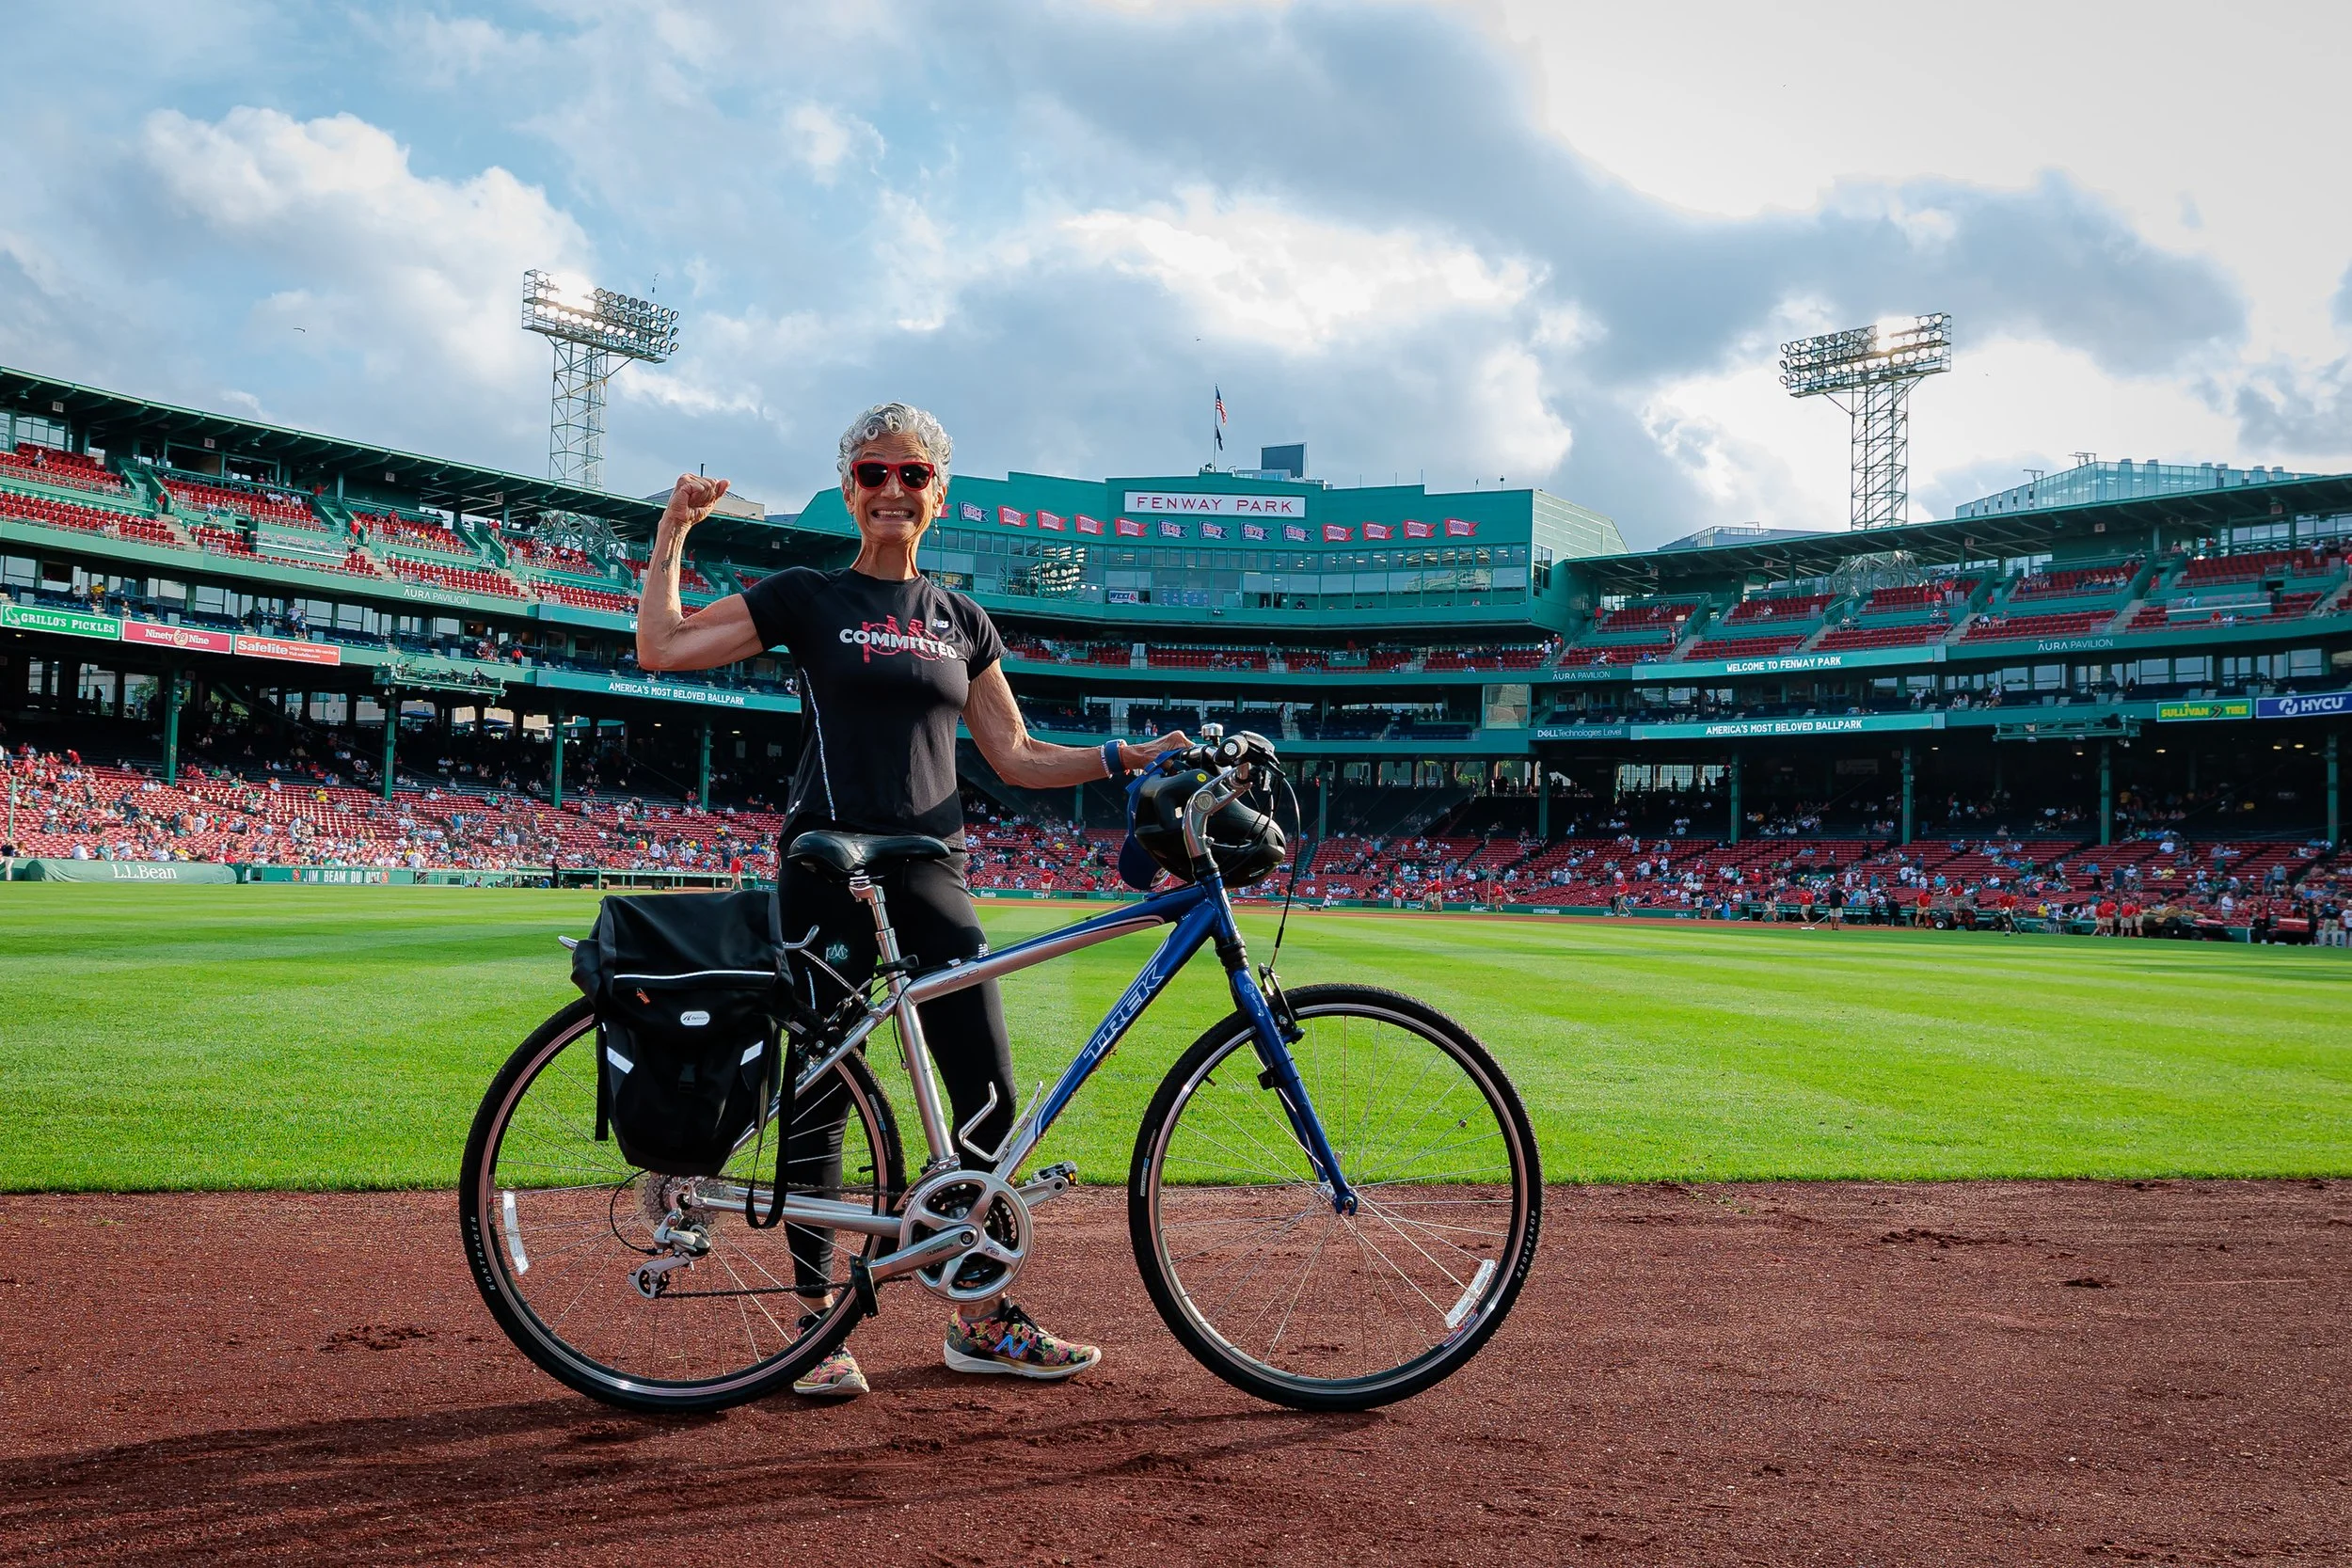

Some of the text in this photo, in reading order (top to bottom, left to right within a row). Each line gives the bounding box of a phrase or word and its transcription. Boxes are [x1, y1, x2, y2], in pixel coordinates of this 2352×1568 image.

[1136, 497, 1293, 514] FENWAY PARK
[433, 593, 469, 605] PAVILION
[21, 612, 116, 633] GRILLO'S PICKLES
[145, 628, 173, 641] Ninety
[189, 634, 210, 645] Nine
[839, 628, 958, 659] COMMITTED
[2070, 639, 2114, 649] PAVILION
[238, 641, 289, 655] Safelite
[1726, 657, 1842, 673] WELCOME TO FENWAY PARK
[1578, 671, 1611, 679] PAVILION
[609, 682, 745, 705] AMERICA'S MOST BELOVED BALLPARK
[2161, 705, 2248, 718] SULLIVAN TIRE
[2301, 697, 2344, 712] HYCU
[1604, 727, 1622, 736] Level
[1706, 720, 1863, 736] AMERICA'S MOST BELOVED BALLPARK
[111, 863, 178, 879] L.L.Bean
[303, 870, 381, 883] JIM BEAM DUOUT
[1083, 963, 1165, 1060] TREK
[1517, 1210, 1536, 1278] BONTRAGER
[470, 1216, 496, 1291] BONTRAGER
